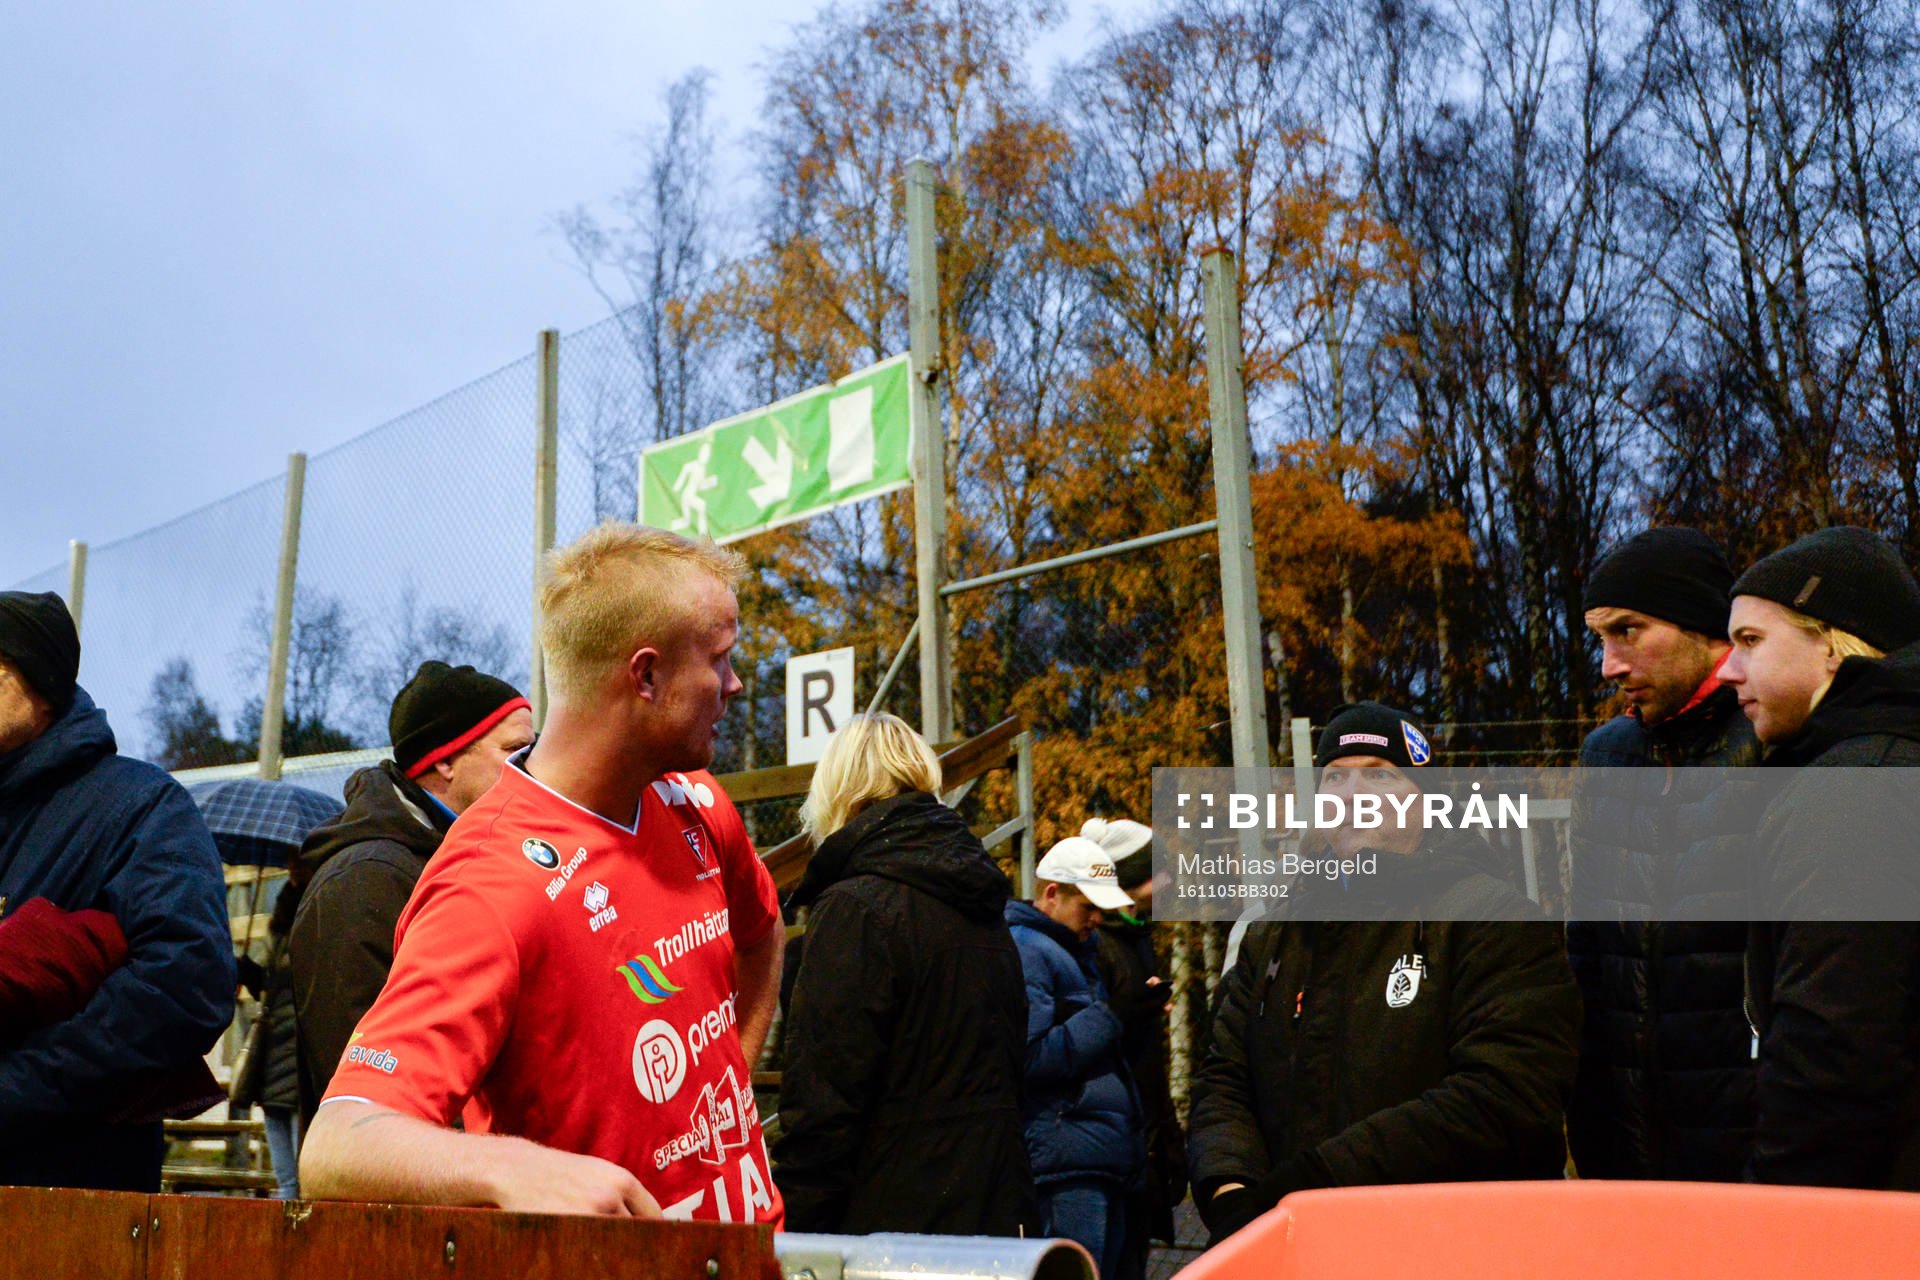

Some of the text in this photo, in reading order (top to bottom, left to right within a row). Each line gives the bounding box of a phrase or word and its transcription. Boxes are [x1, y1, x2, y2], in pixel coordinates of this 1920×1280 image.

[802, 670, 837, 738] R
[545, 847, 588, 902] Bilia Group
[654, 1126, 706, 1170] SPECIAL
